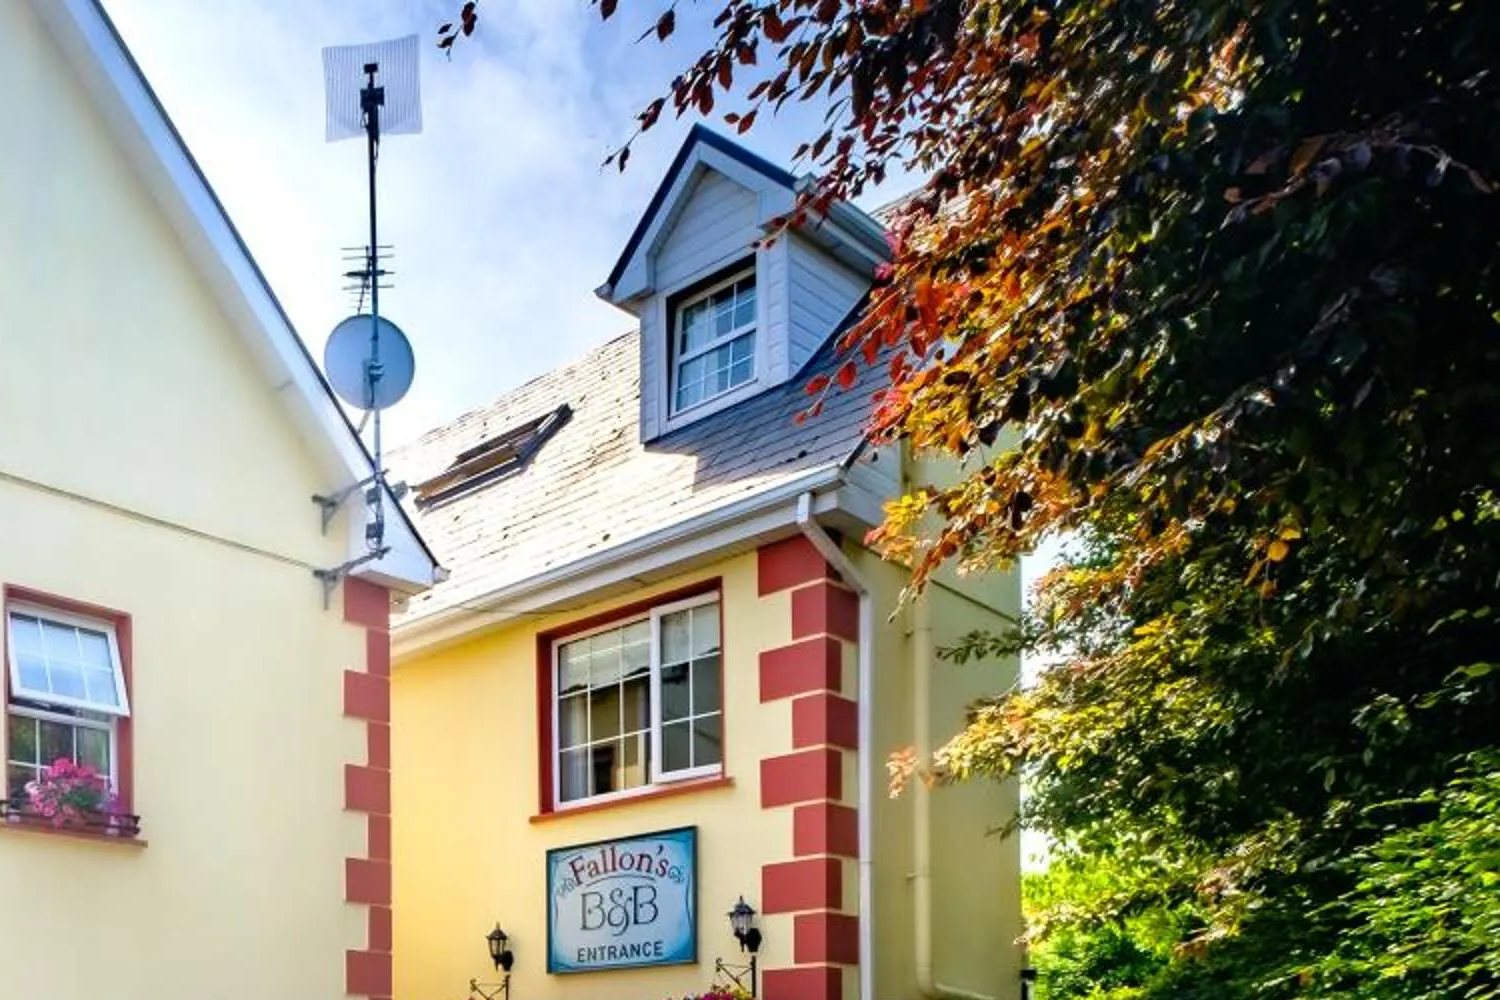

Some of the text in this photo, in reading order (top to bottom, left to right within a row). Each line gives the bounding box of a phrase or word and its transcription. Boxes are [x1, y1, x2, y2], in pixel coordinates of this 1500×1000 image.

[569, 844, 670, 886] Fallon's
[580, 885, 659, 937] B&B
[577, 941, 664, 963] ENTRANCE
